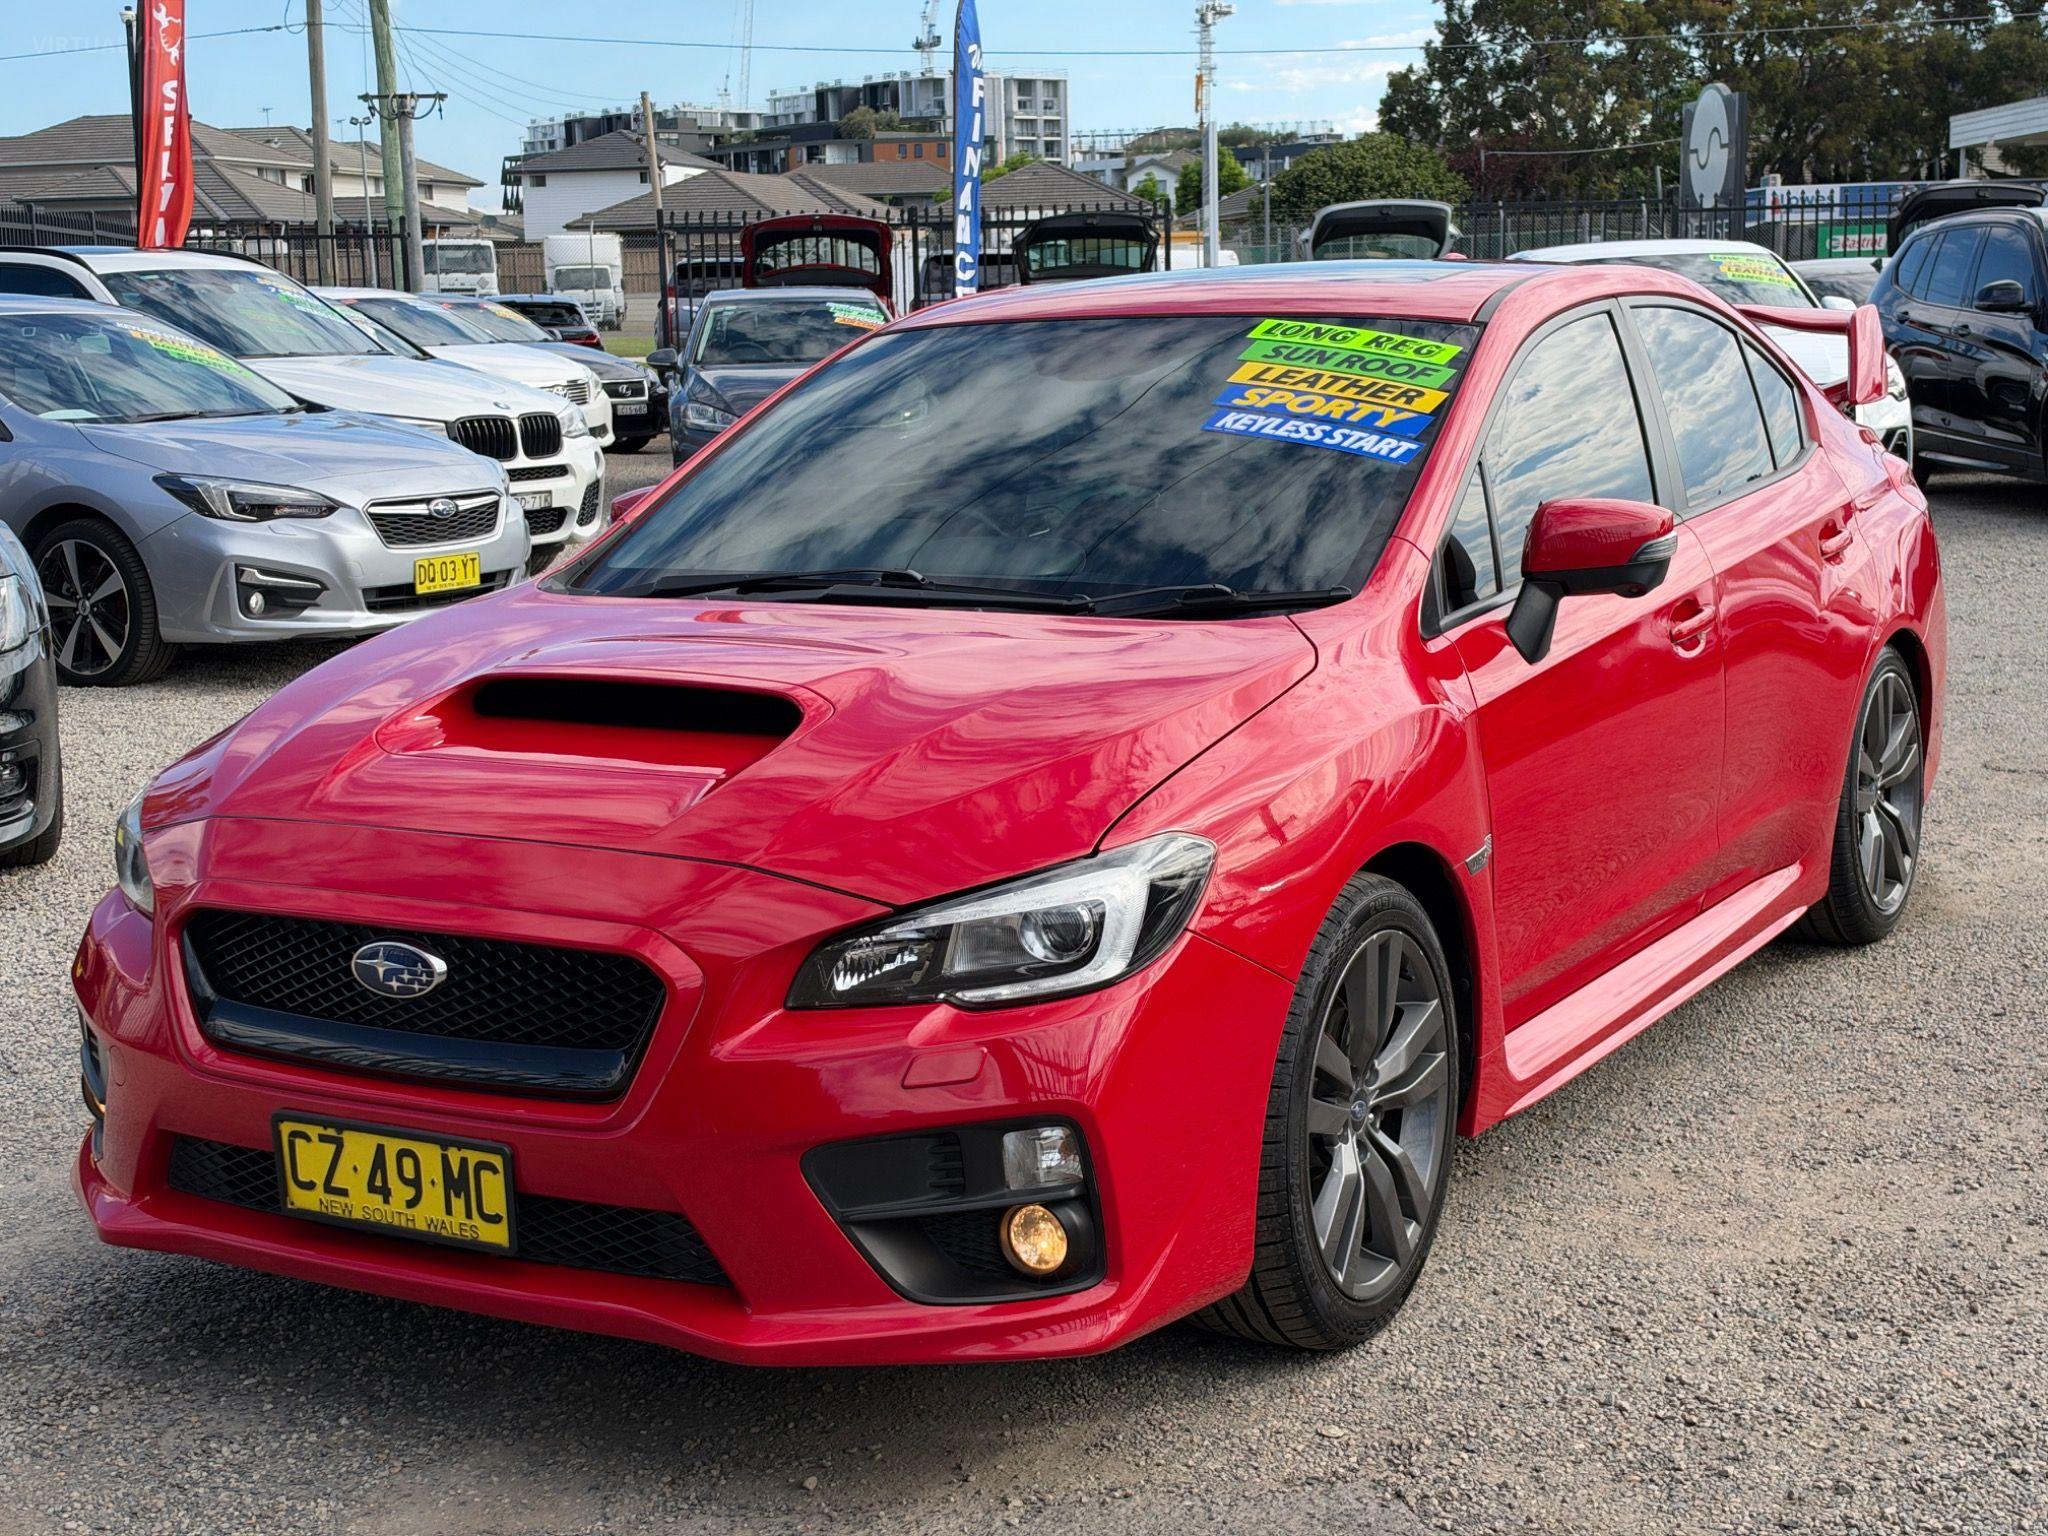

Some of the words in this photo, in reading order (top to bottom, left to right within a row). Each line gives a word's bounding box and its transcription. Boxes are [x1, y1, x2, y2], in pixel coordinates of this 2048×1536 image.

[1262, 322, 1359, 344] LONG
[1365, 335, 1446, 358] REG
[1262, 345, 1335, 367] SUN
[1335, 354, 1441, 380] ROOF
[1249, 367, 1426, 406] LEATHER
[1232, 388, 1416, 428] SPORTY
[1214, 411, 1324, 441] KEYLESS
[1323, 428, 1419, 459] START
[318, 1197, 353, 1218] NEW
[362, 1204, 416, 1229] SOUTH
[424, 1215, 480, 1240] WALES
